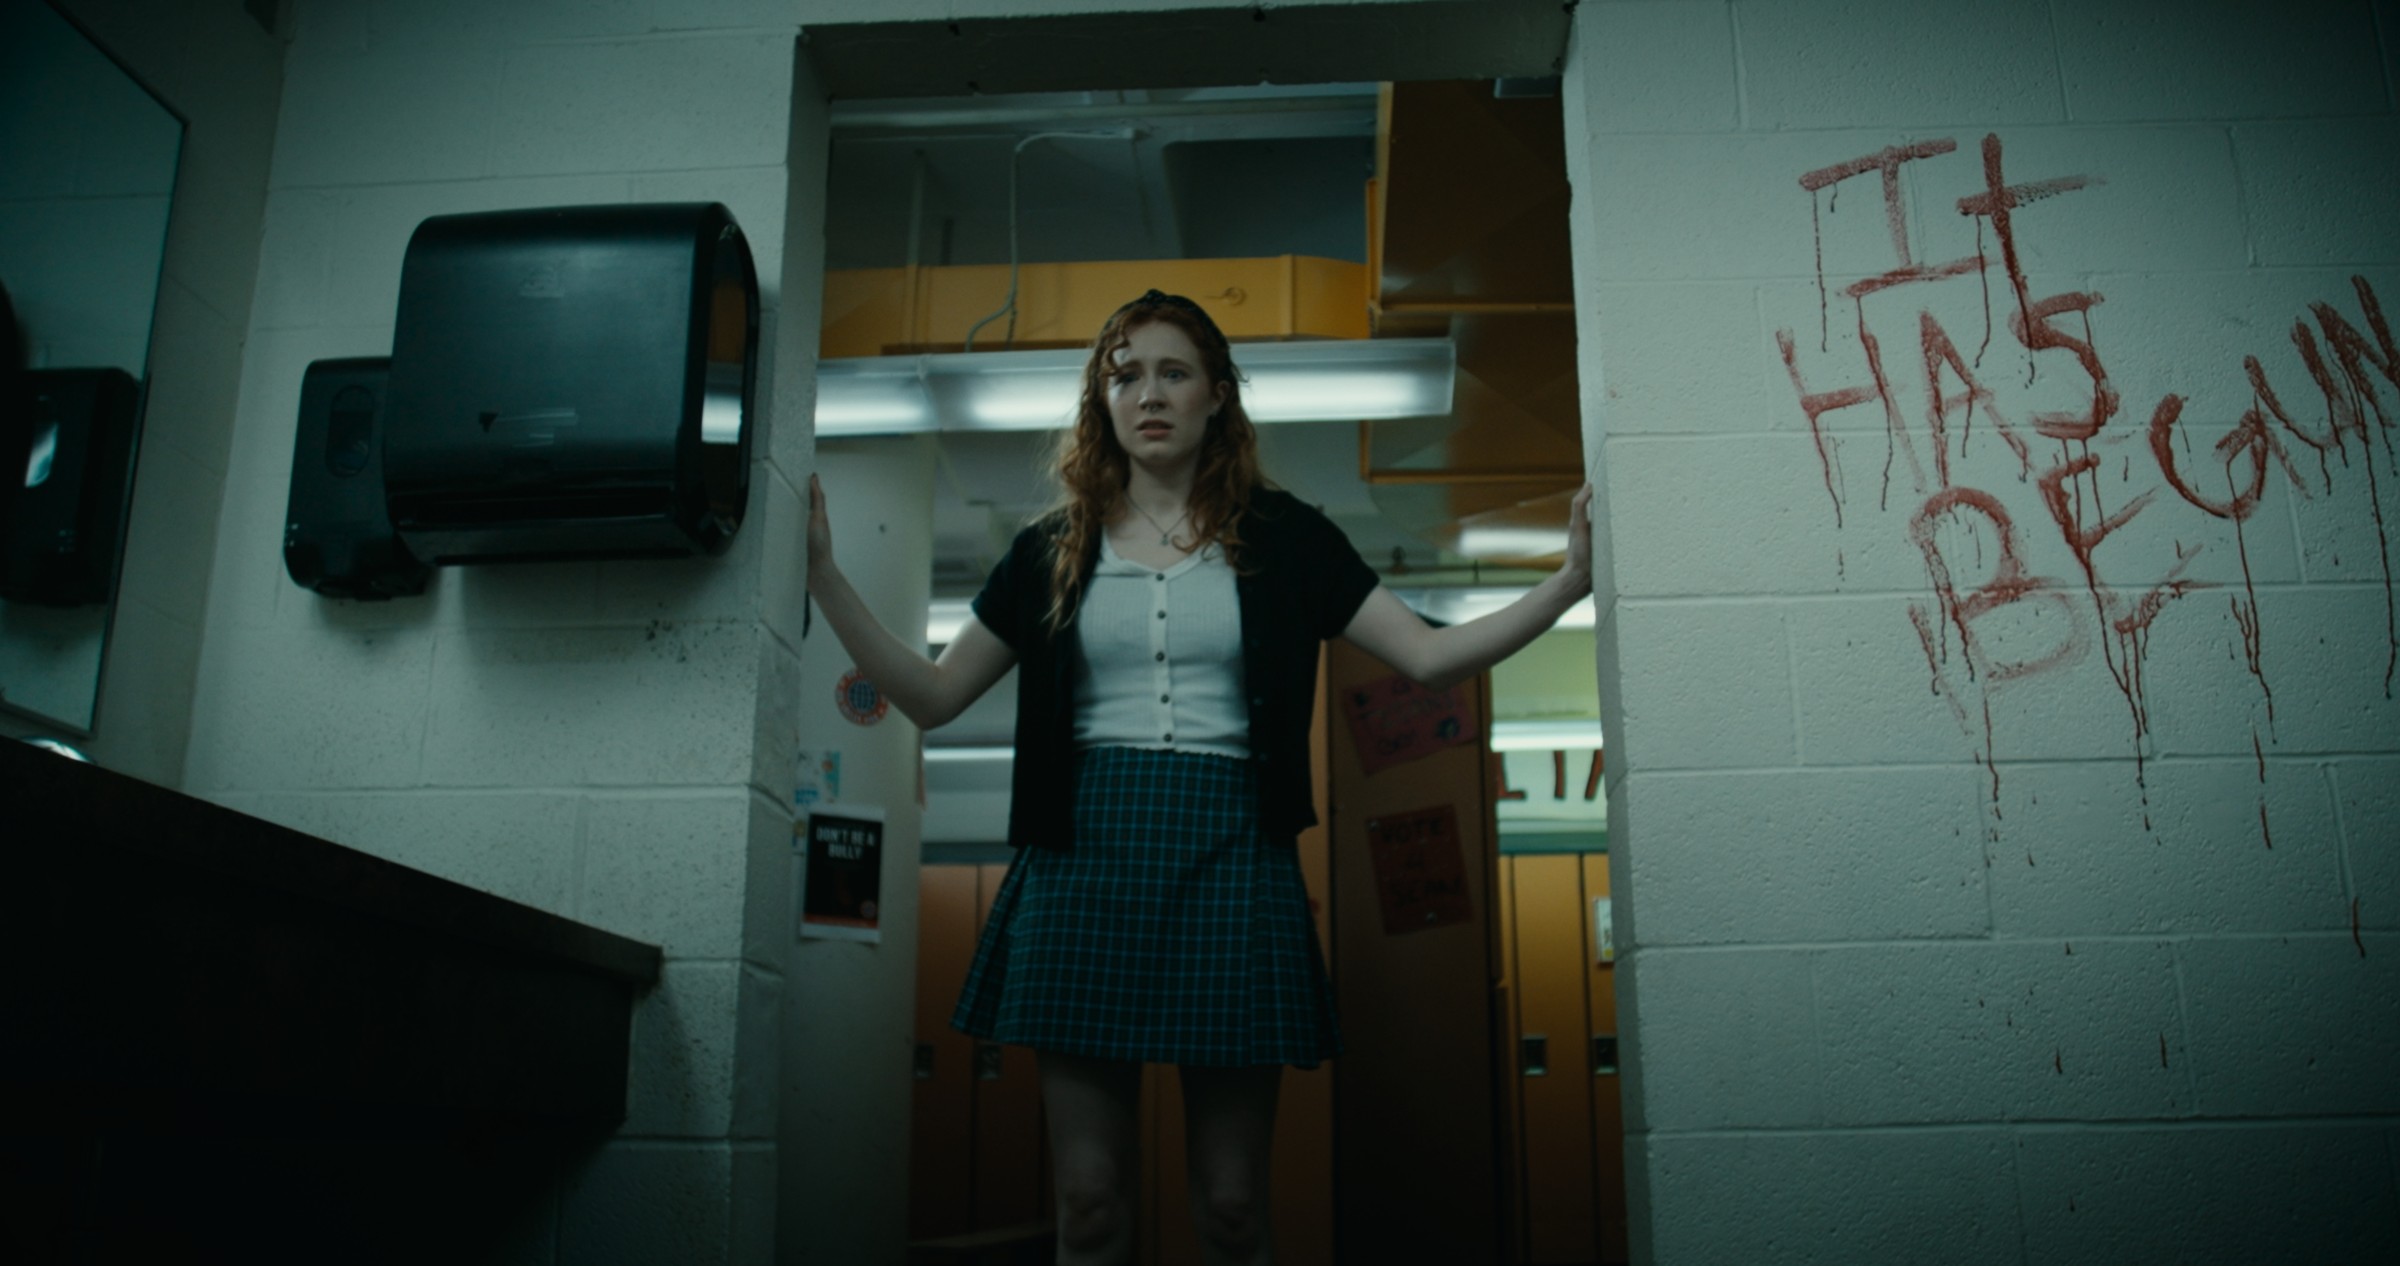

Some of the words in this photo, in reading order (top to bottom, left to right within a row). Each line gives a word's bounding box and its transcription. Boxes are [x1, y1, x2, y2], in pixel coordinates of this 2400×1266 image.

[1799, 132, 2107, 306] It
[1776, 292, 2120, 492] HAS
[1908, 275, 2400, 690] BEGUN
[816, 825, 849, 844] DON'T
[850, 828, 866, 846] BE
[866, 830, 877, 848] A
[827, 843, 864, 861] BULLY
